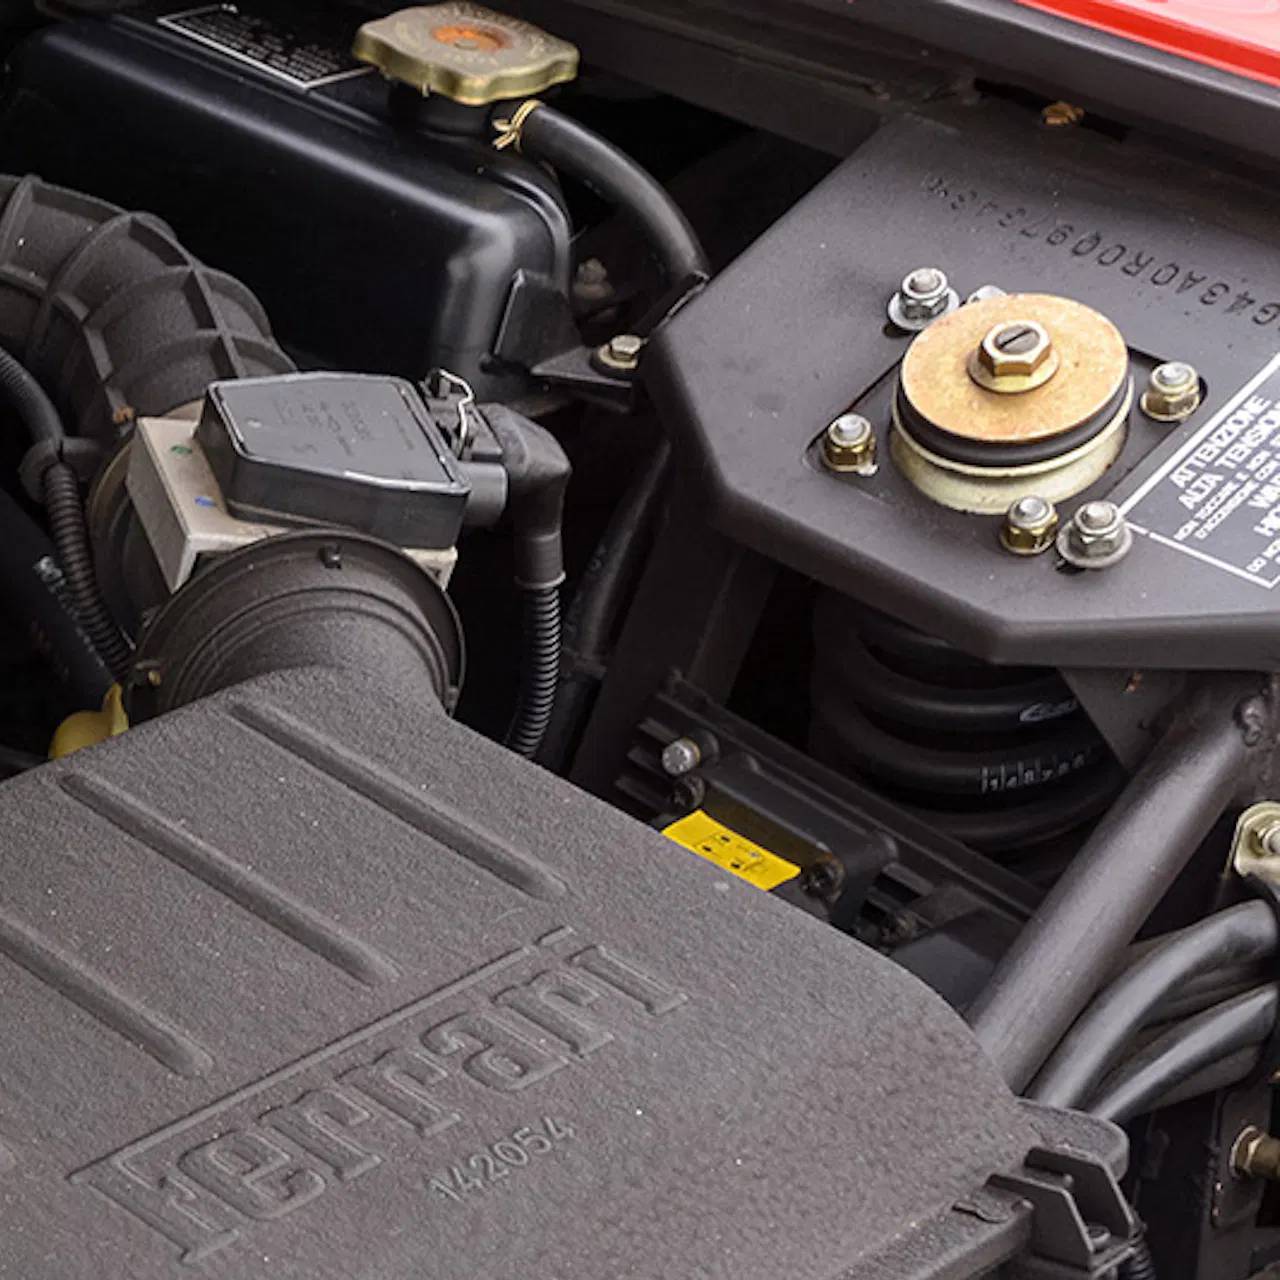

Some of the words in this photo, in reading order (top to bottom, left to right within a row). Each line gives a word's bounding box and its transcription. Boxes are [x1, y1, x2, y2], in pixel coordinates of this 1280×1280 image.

[1169, 395, 1272, 489] ATTENZIONE
[1179, 472, 1225, 511] ALTA
[68, 925, 687, 1266] Ferrari
[426, 1115, 578, 1204] 142054
